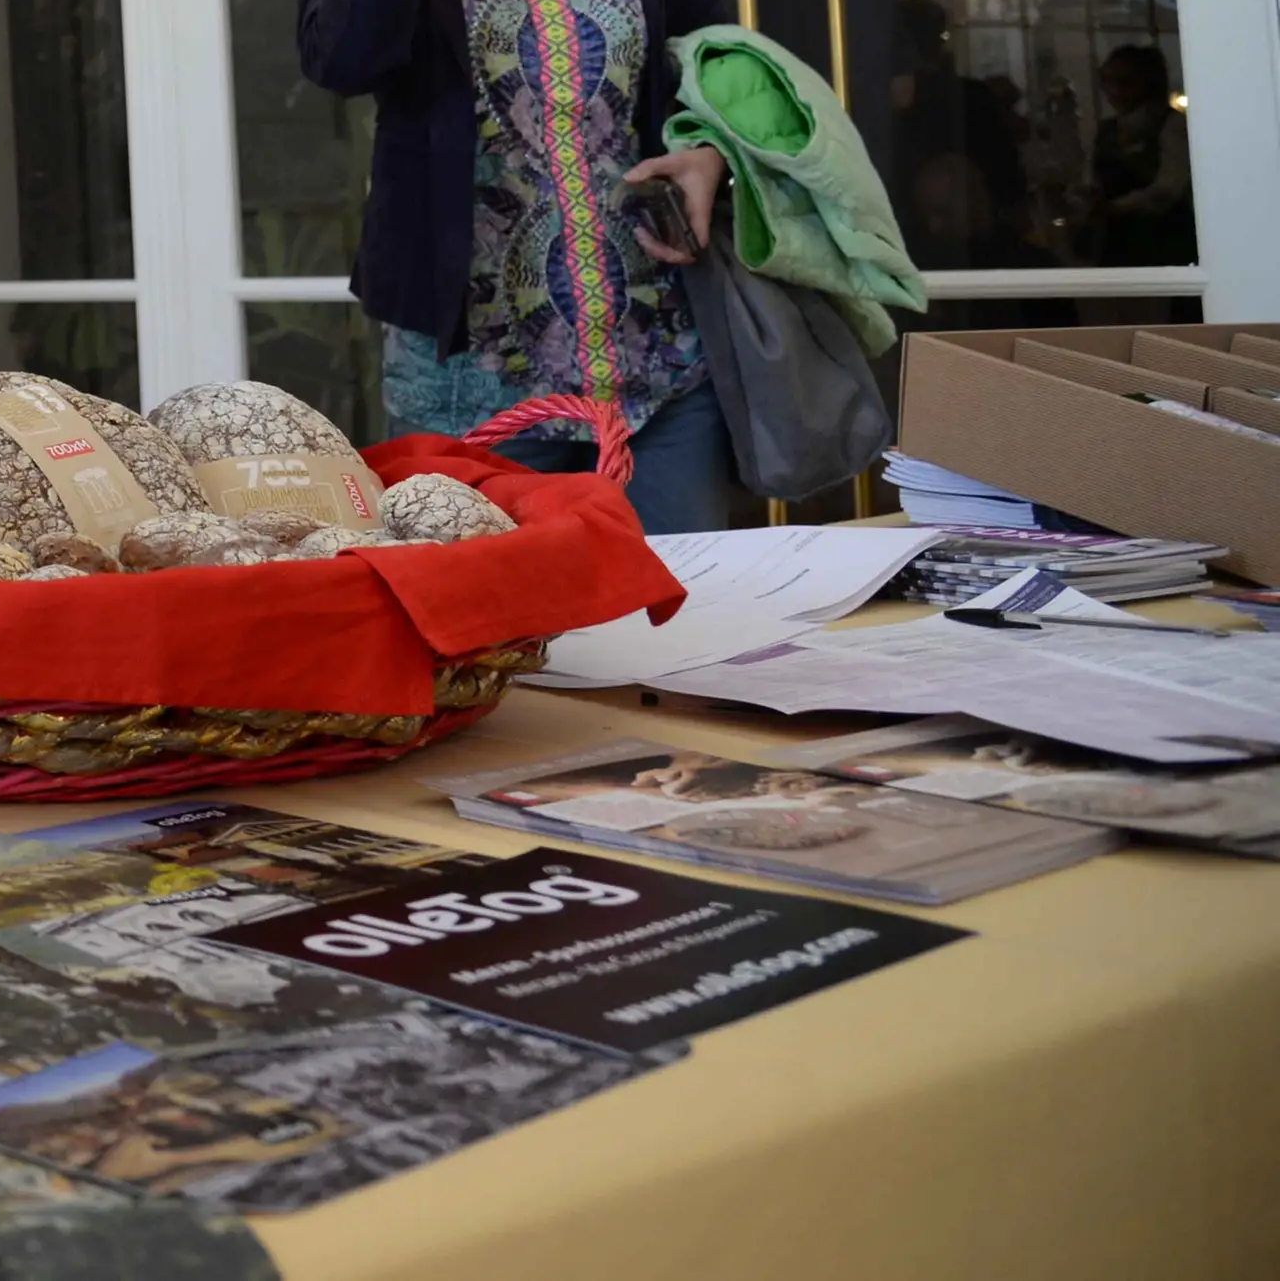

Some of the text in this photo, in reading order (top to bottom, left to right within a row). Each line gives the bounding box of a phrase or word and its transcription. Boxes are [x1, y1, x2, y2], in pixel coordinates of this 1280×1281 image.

[46, 438, 92, 458] 700xM
[342, 474, 368, 517] 700xM
[303, 874, 640, 957] olleTog
